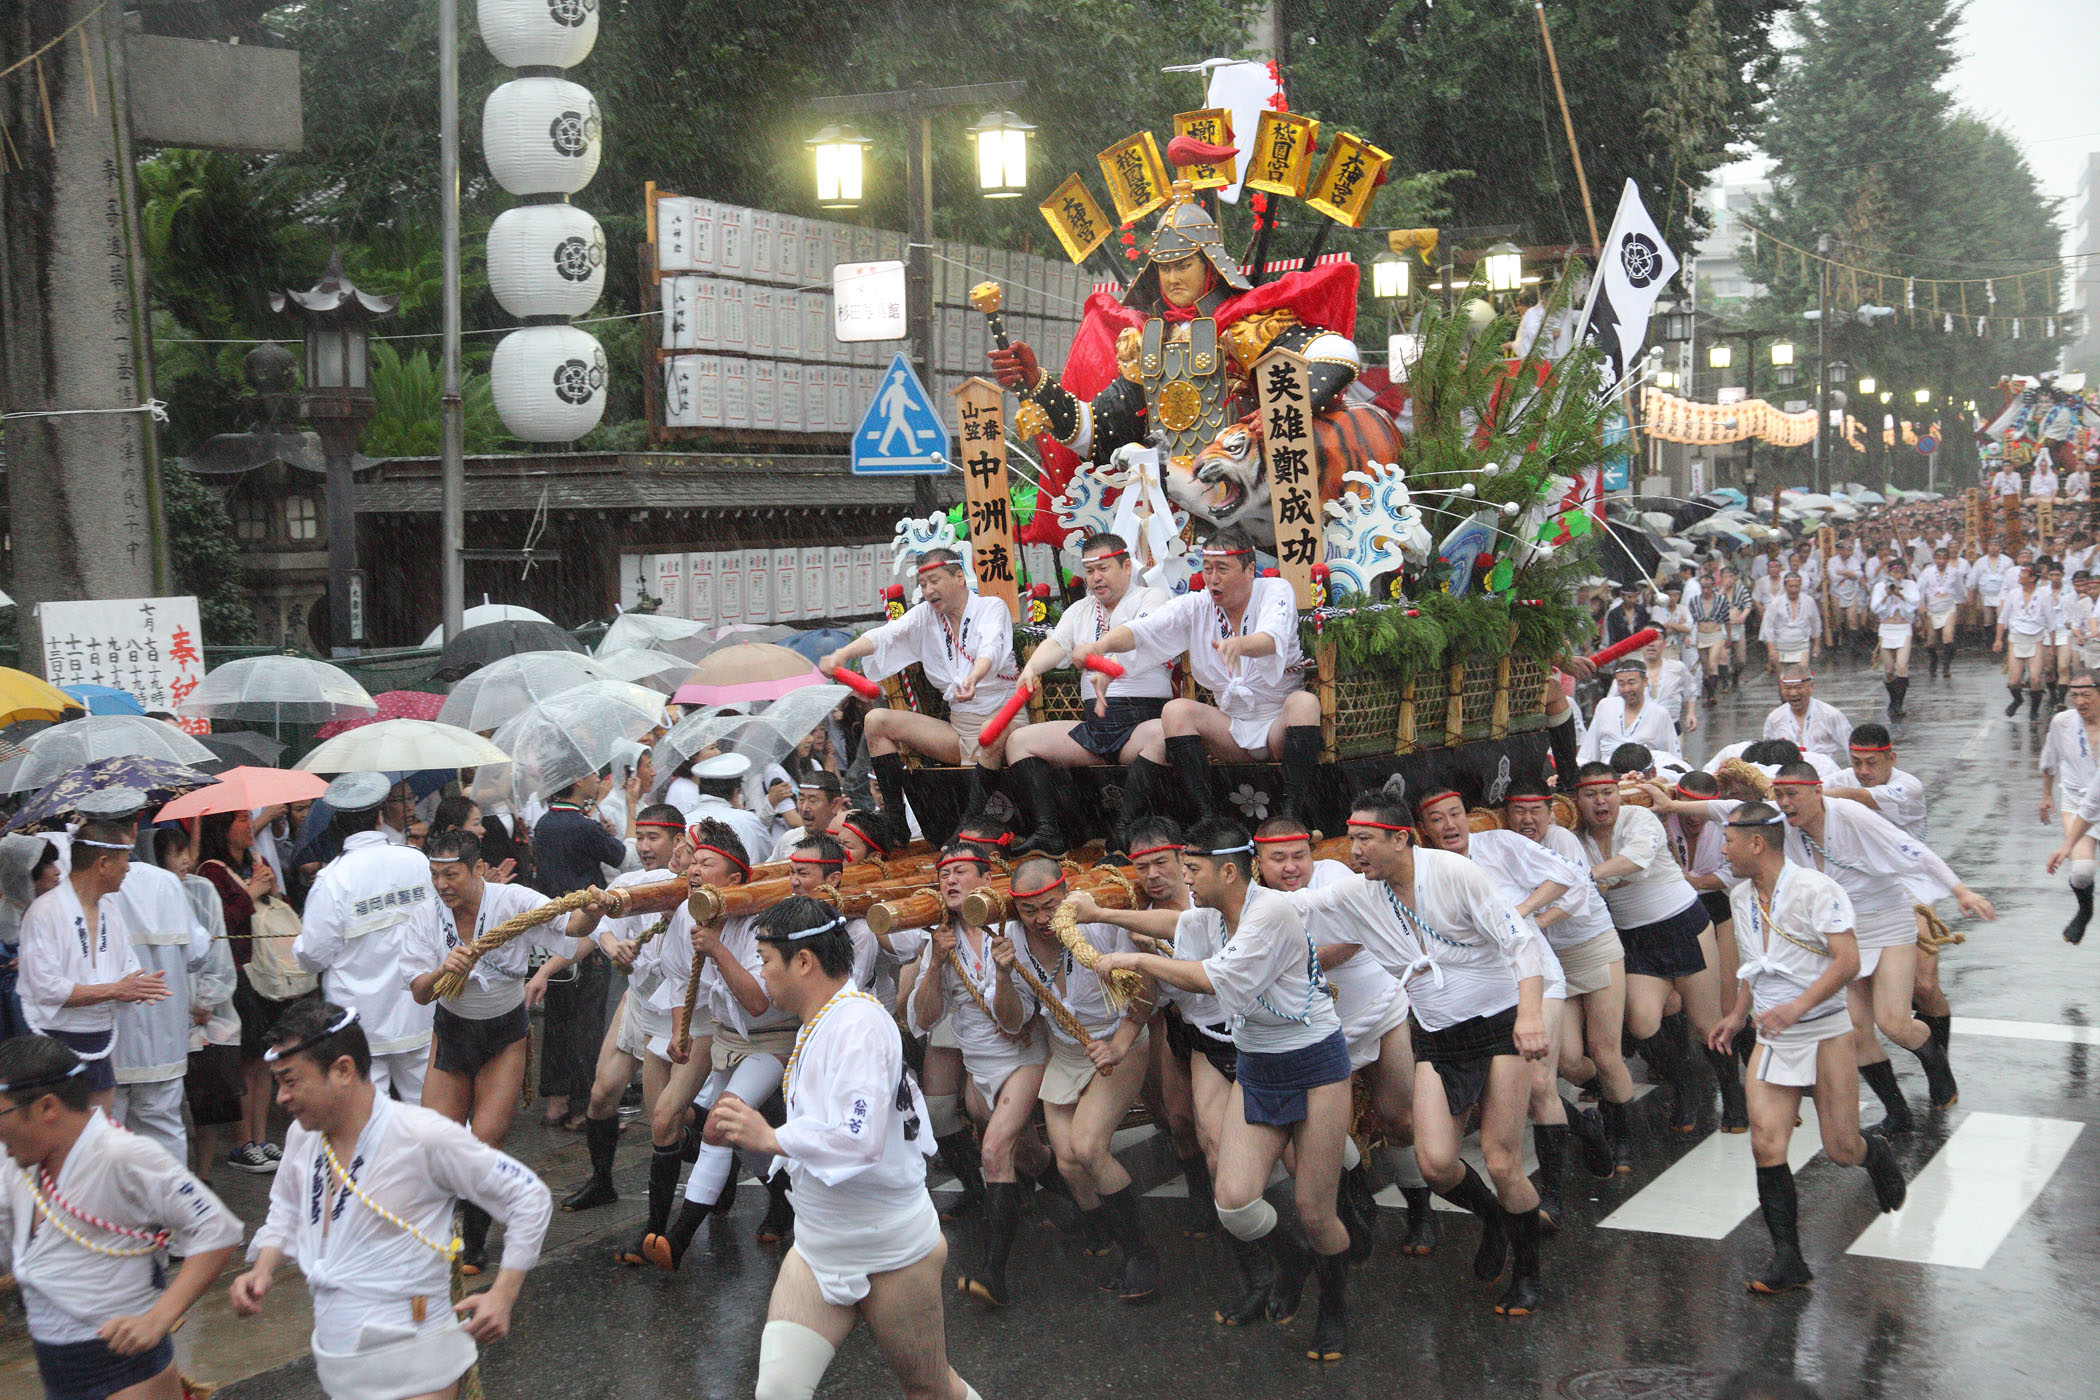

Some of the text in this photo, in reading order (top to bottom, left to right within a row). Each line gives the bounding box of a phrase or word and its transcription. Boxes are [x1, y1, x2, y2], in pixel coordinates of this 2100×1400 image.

[1187, 120, 1216, 179] 櫛宮
[968, 450, 1014, 583] 中洲流
[1266, 361, 1318, 566] 英雄鄭成功
